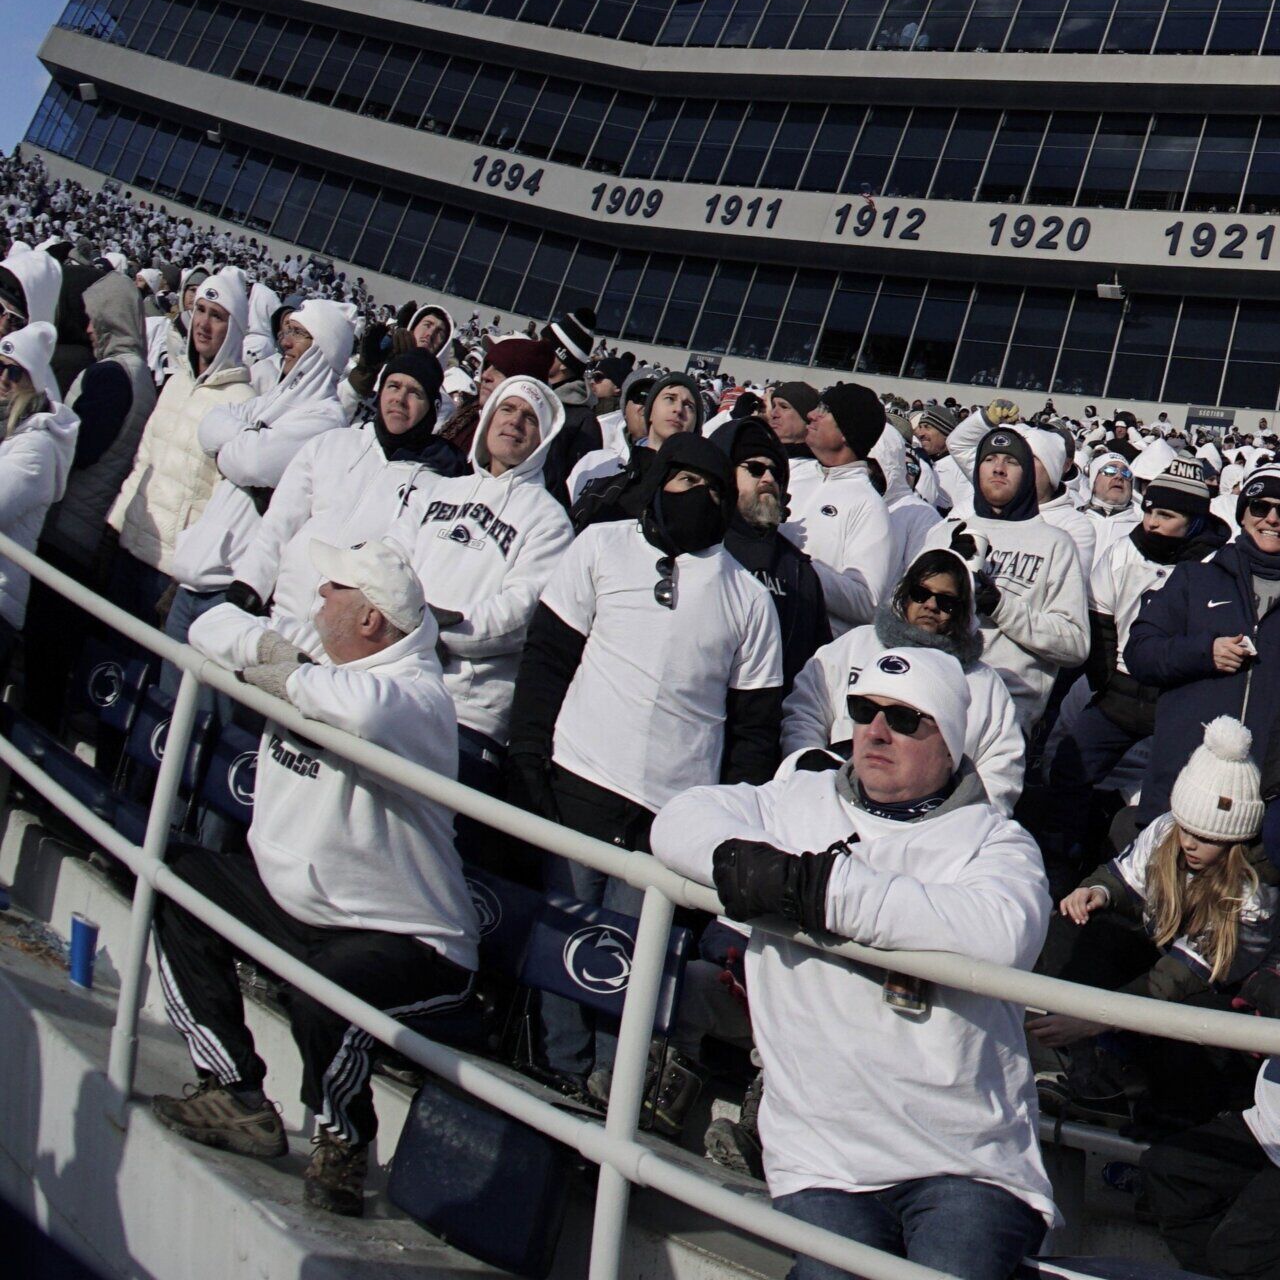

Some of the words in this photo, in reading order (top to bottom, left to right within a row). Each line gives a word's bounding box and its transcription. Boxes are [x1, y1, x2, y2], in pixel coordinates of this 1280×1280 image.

[472, 155, 545, 197] 1894
[591, 182, 664, 219] 1909
[705, 193, 783, 230] 1911
[834, 199, 927, 241] 1912
[988, 212, 1091, 252] 1920
[1164, 221, 1276, 261] 1921
[1199, 410, 1225, 418] SECTION
[469, 503, 518, 560] STATE
[988, 550, 1044, 583] STATE
